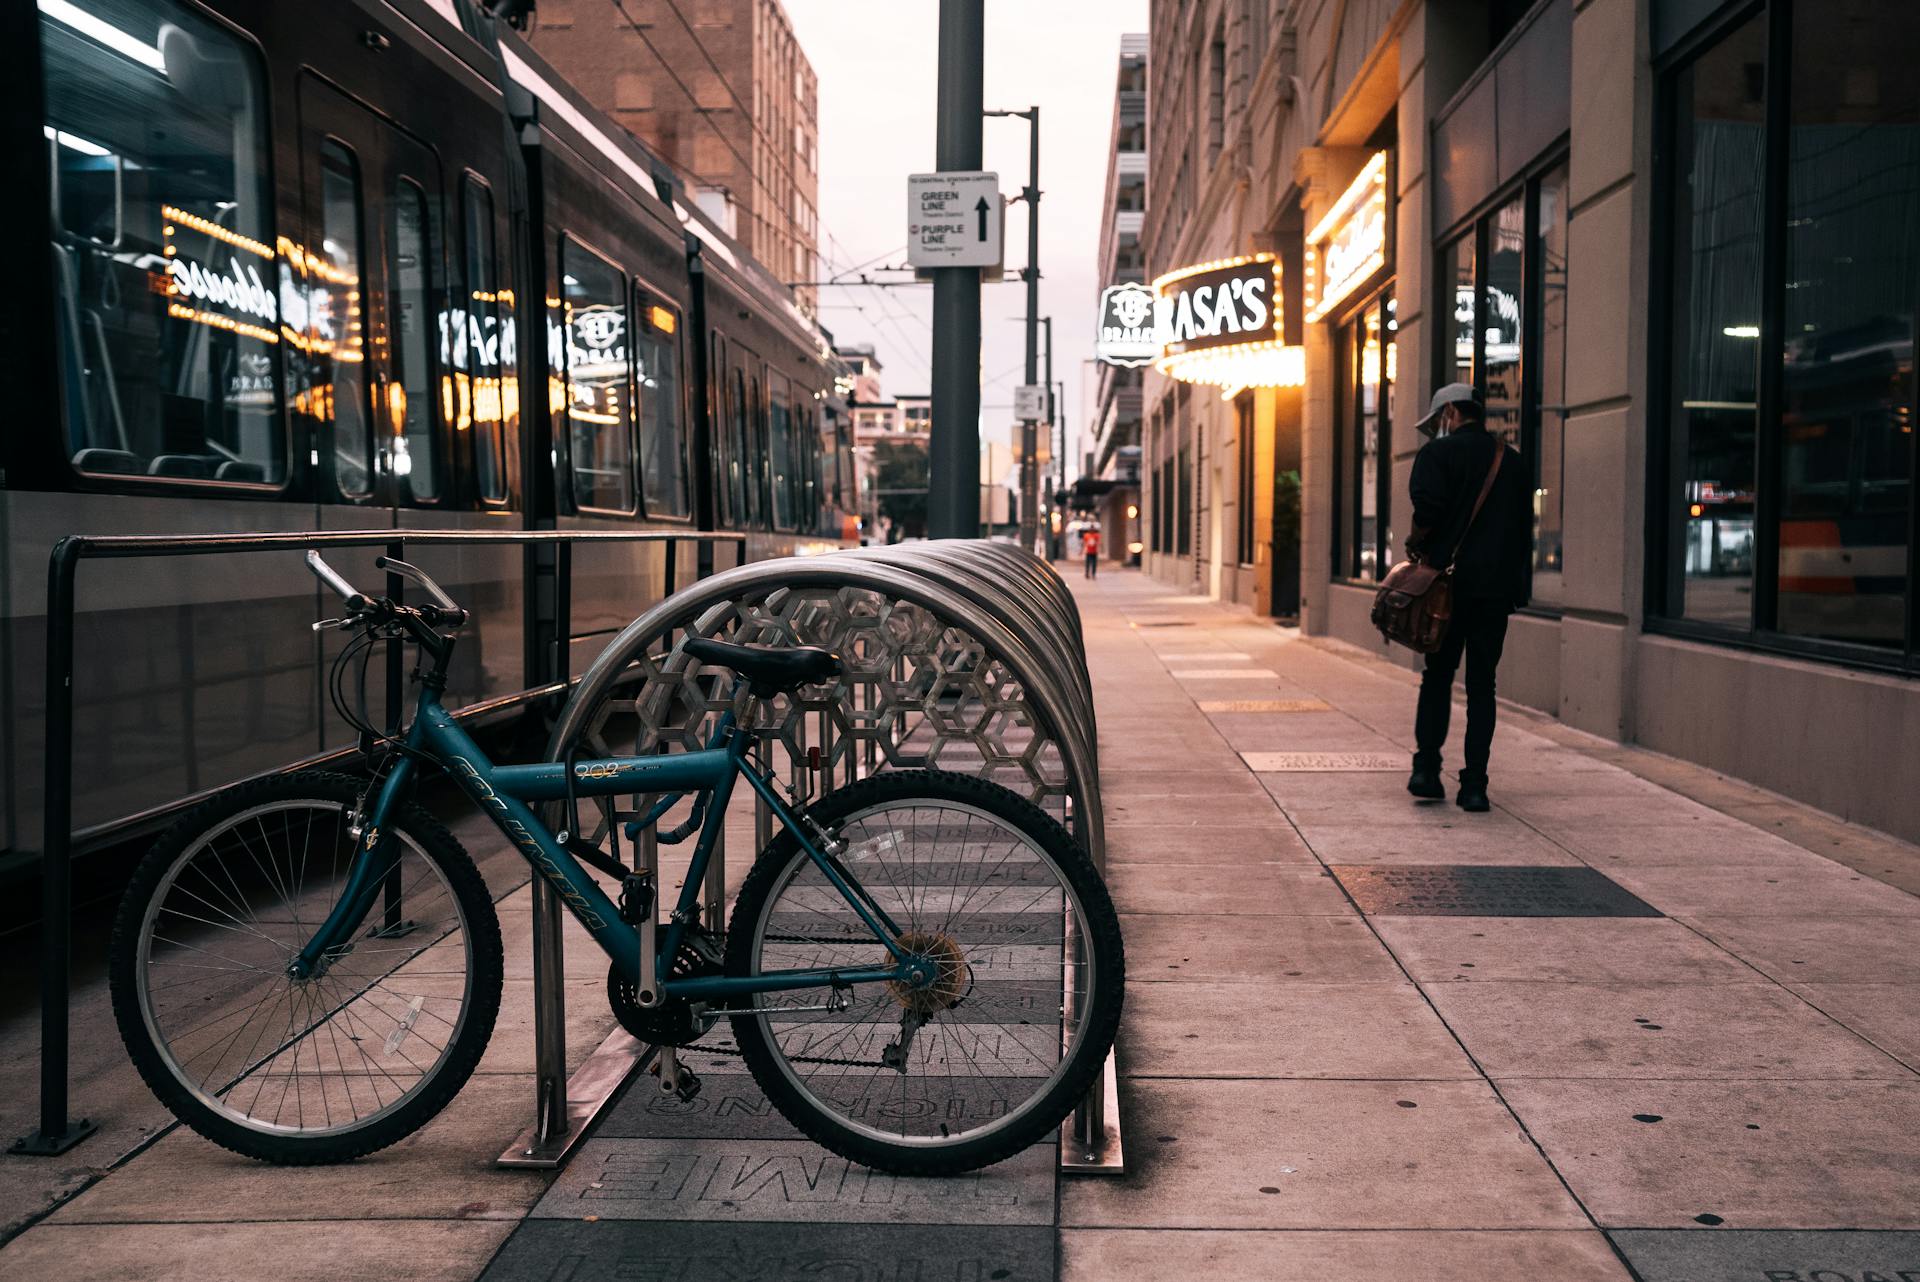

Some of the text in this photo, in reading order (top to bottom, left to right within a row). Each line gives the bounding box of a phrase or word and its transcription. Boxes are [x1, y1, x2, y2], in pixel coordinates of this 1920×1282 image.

[921, 191, 960, 201] GREEN
[921, 201, 945, 211] LINE
[921, 224, 964, 234] PURPLE
[921, 234, 945, 244] LINE
[574, 762, 619, 780] 902
[643, 1095, 1010, 1120] TICKNG
